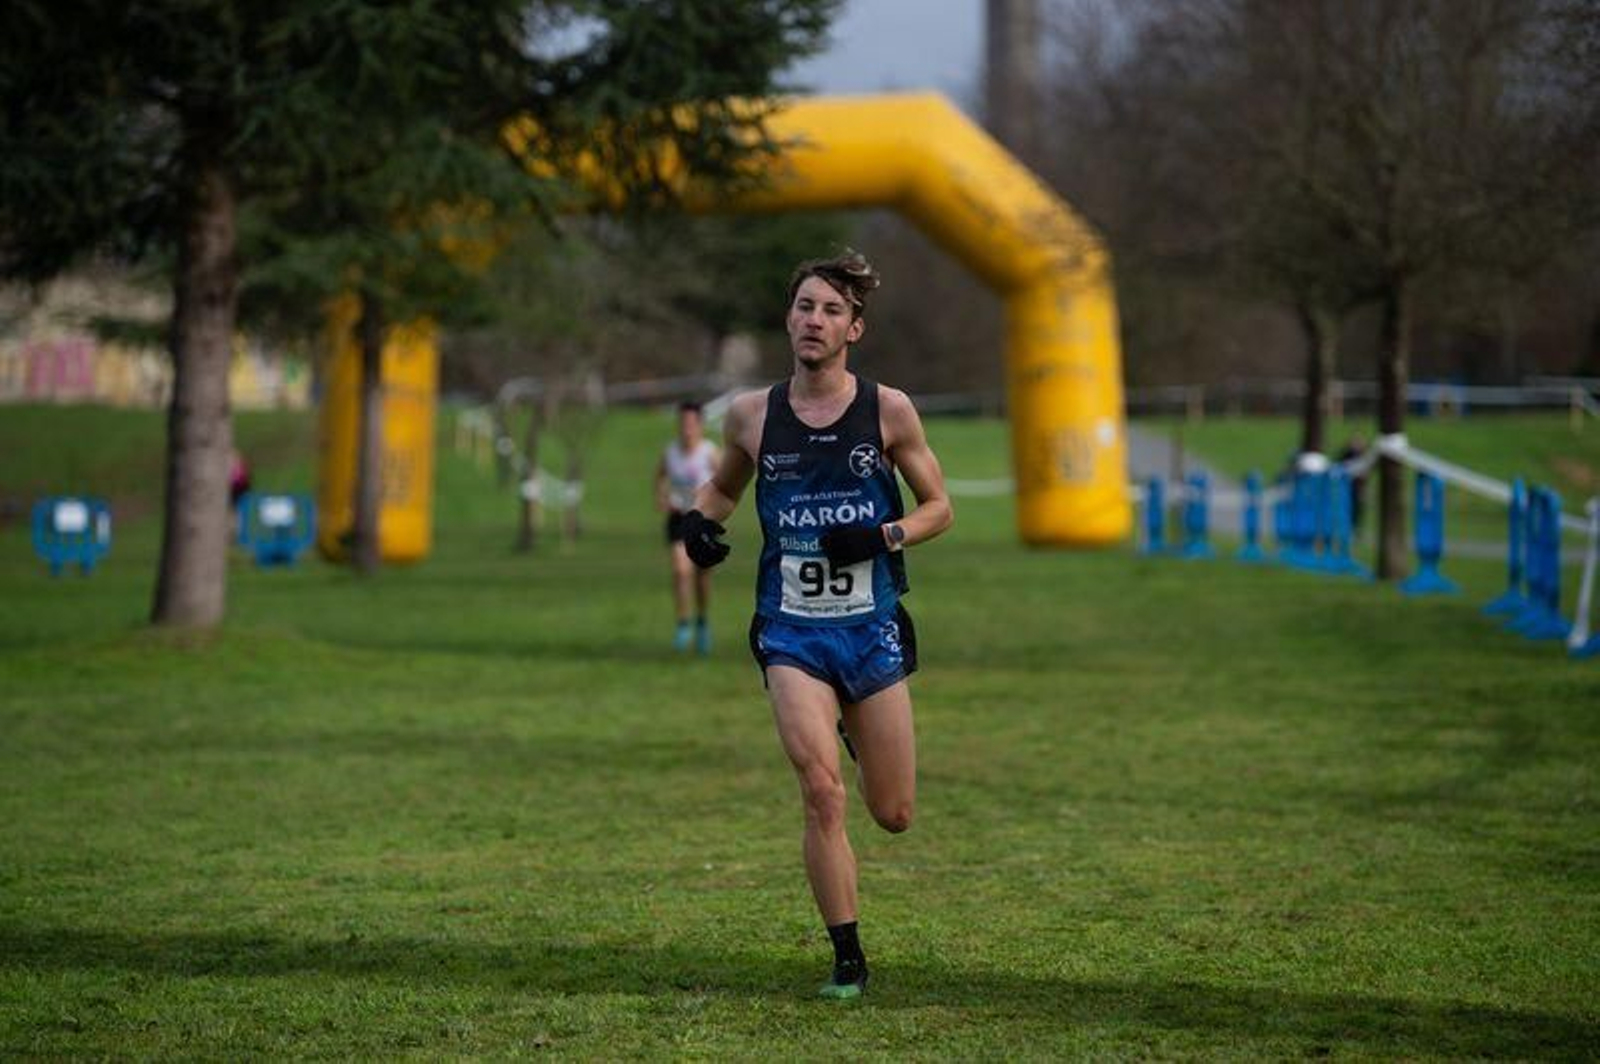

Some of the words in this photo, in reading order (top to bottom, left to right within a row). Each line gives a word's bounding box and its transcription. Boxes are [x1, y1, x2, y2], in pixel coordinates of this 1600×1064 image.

[779, 499, 875, 528] NARÓN
[780, 537, 823, 552] Ribad
[800, 561, 854, 598] 95
